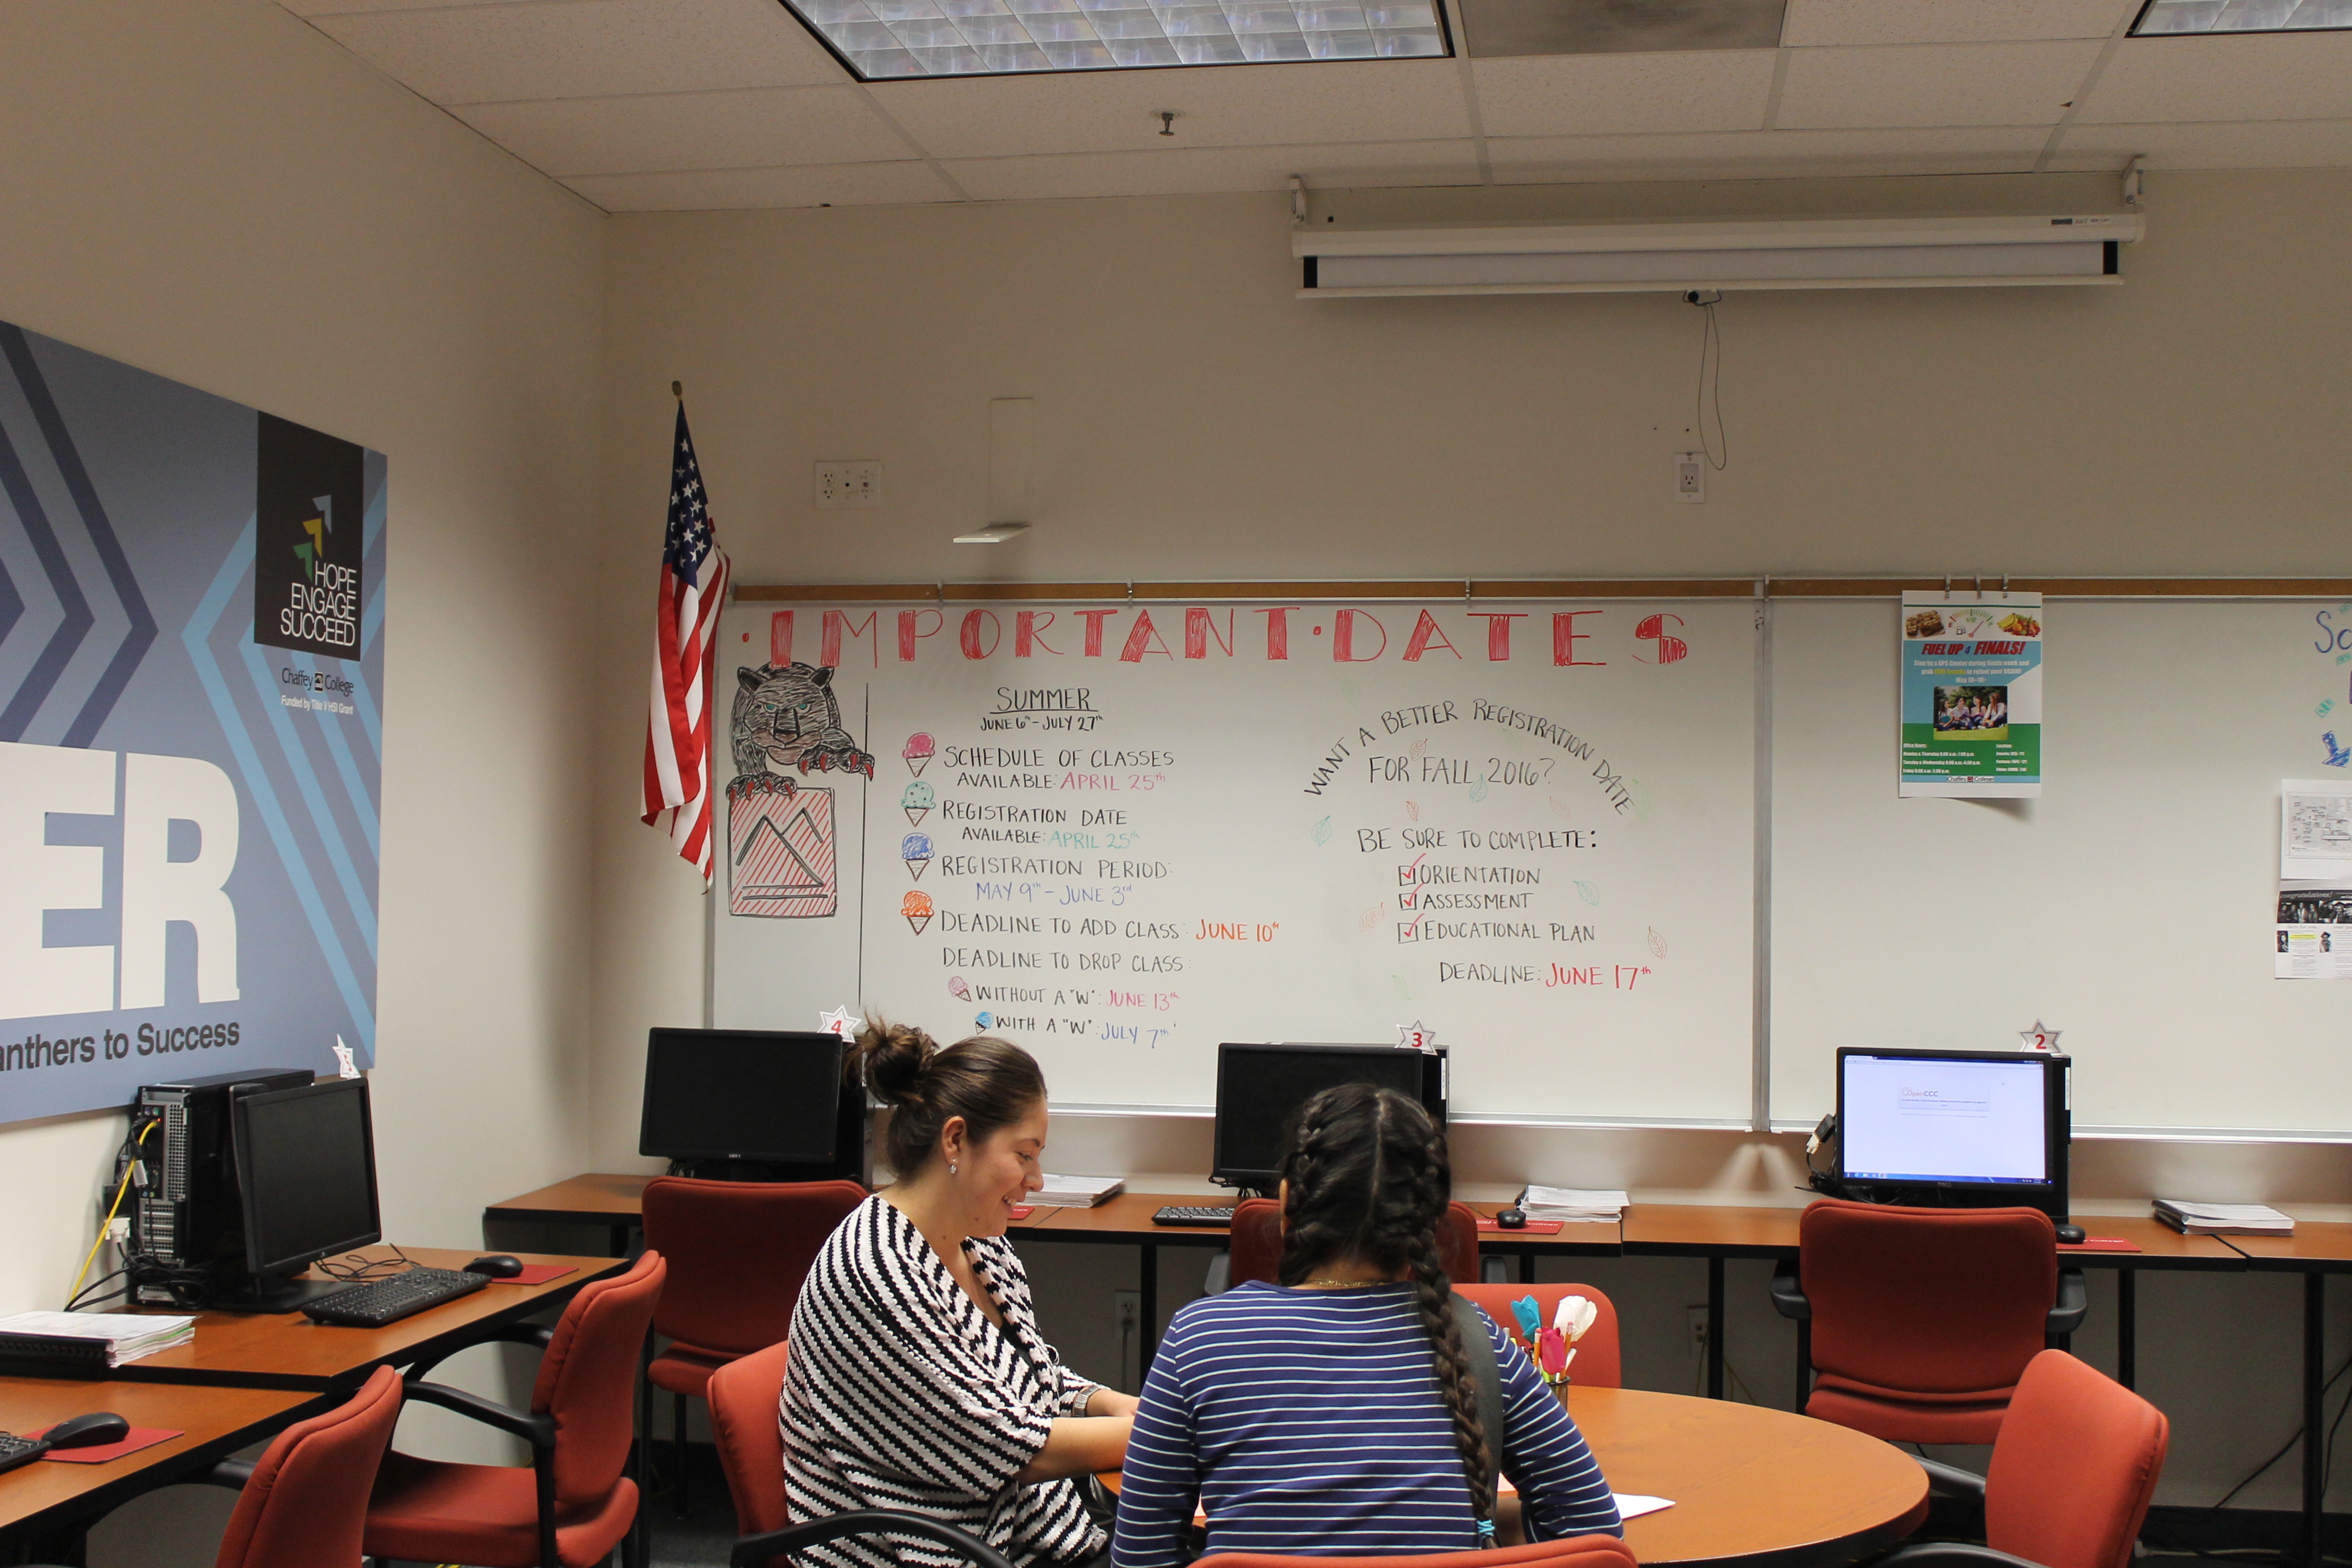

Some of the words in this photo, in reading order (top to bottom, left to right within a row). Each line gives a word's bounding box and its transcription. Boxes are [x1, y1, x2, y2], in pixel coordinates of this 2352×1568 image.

[315, 560, 357, 595] HOPE
[291, 582, 356, 621] ENGAGE
[281, 608, 355, 647] SUCCEED
[771, 607, 1300, 668] IMPORTANT
[1333, 608, 1687, 667] DATES
[1921, 643, 1947, 655] FUEL
[1947, 643, 1964, 655] UP
[1964, 645, 1971, 655] 4
[1974, 641, 2027, 655] FINALS!
[282, 668, 313, 690] Chaffey
[325, 675, 353, 697] College
[281, 695, 303, 708] Funded
[303, 699, 311, 711] by
[339, 703, 353, 715] Grant
[997, 687, 1091, 711] SUMMER
[981, 717, 1013, 731] JUNE
[1043, 717, 1072, 731] JULY
[1078, 714, 1104, 731] 27th
[944, 746, 1044, 767] SCHEDULE
[1058, 749, 1083, 767] OF
[1091, 749, 1174, 767] CLASSES
[1304, 737, 1351, 796] WANT
[1359, 727, 1375, 747] A
[1381, 700, 1458, 734] BETTER
[1473, 698, 1595, 762] REGISTRATION
[1592, 759, 1635, 816] DATE
[957, 772, 1057, 789] AVAILABLE:
[1060, 772, 1120, 791] APRIL
[1129, 772, 1166, 791] 25th
[1369, 756, 1409, 784] FOR
[1422, 756, 1473, 785] FALL
[1487, 757, 1555, 786] 2016?
[943, 800, 1066, 824] REGISTRATION
[1082, 809, 1127, 826] DATE
[962, 827, 1046, 844] AVAILABLE:
[1047, 830, 1099, 850] APRIL
[1106, 831, 1140, 850] 25th
[1357, 828, 1391, 853] BE
[1402, 828, 1447, 848] SURE
[1457, 830, 1481, 848] TO
[1489, 830, 1597, 851] COMPLETE:
[942, 856, 1082, 877] REGISTRATION
[1099, 859, 1173, 879] PERIOD:
[1420, 864, 1540, 885] ORIENTATION
[976, 882, 1015, 902] MAY
[1020, 881, 1041, 903] 9th
[1060, 885, 1103, 906] JUNE
[1112, 884, 1133, 906] 3rd
[1423, 892, 1533, 910] ASSESSMENT
[2280, 891, 2333, 900] congratulations!
[940, 910, 1042, 934] DEADLINE
[1049, 917, 1071, 934] TO
[1080, 918, 1117, 936] ADD
[1126, 921, 1189, 939] CLASS:
[1196, 919, 1248, 941] JUNE
[1256, 921, 1280, 942] 10th
[1424, 921, 1541, 940] EDUCATIONAL
[1549, 923, 1595, 943] PLAN
[943, 948, 1042, 968] DEADLINE
[1049, 951, 1069, 970] TO
[1080, 952, 1121, 972] DROP
[1131, 955, 1191, 973] CLASS:
[1440, 962, 1541, 985] DEADLINE:
[1545, 962, 1603, 988] JUNE
[1615, 965, 1652, 990] 17th
[976, 985, 1046, 1004] WITHOUT
[1054, 990, 1066, 1005] A
[1106, 990, 1146, 1008] JUNE
[1154, 991, 1180, 1011] 13th
[831, 1020, 842, 1035] 4
[996, 1015, 1036, 1032] WITH
[1046, 1018, 1057, 1033] A
[1101, 1022, 1138, 1044] JULY
[1147, 1027, 1170, 1049] 7th
[1411, 1032, 1423, 1048] 3
[104, 1029, 129, 1060] to
[137, 1022, 239, 1055] Success
[2035, 1033, 2046, 1050] 2
